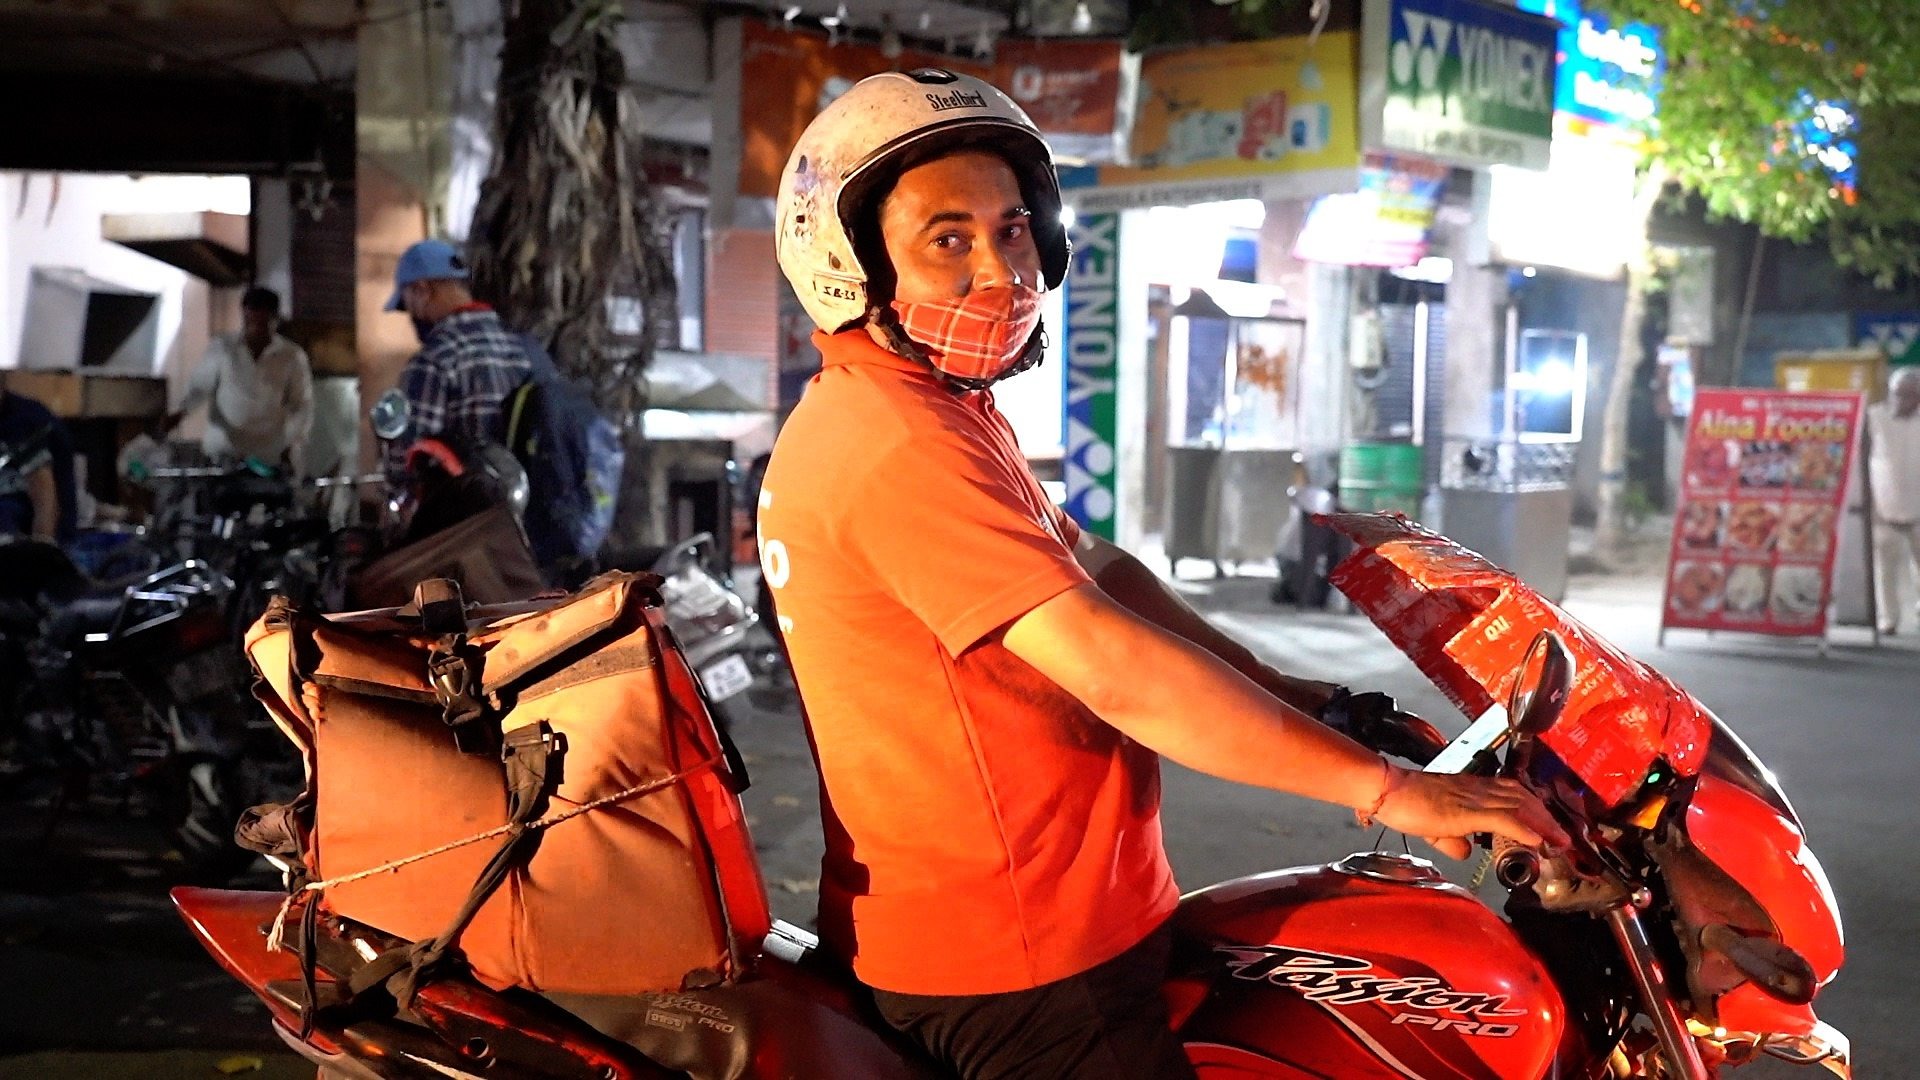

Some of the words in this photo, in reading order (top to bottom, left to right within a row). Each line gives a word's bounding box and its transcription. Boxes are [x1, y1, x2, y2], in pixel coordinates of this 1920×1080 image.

[925, 90, 987, 111] Steelbird
[1456, 22, 1549, 112] YONEX
[1068, 215, 1116, 404] YONEX
[1214, 944, 1528, 1017] Passion
[1391, 1011, 1519, 1038] PRO
